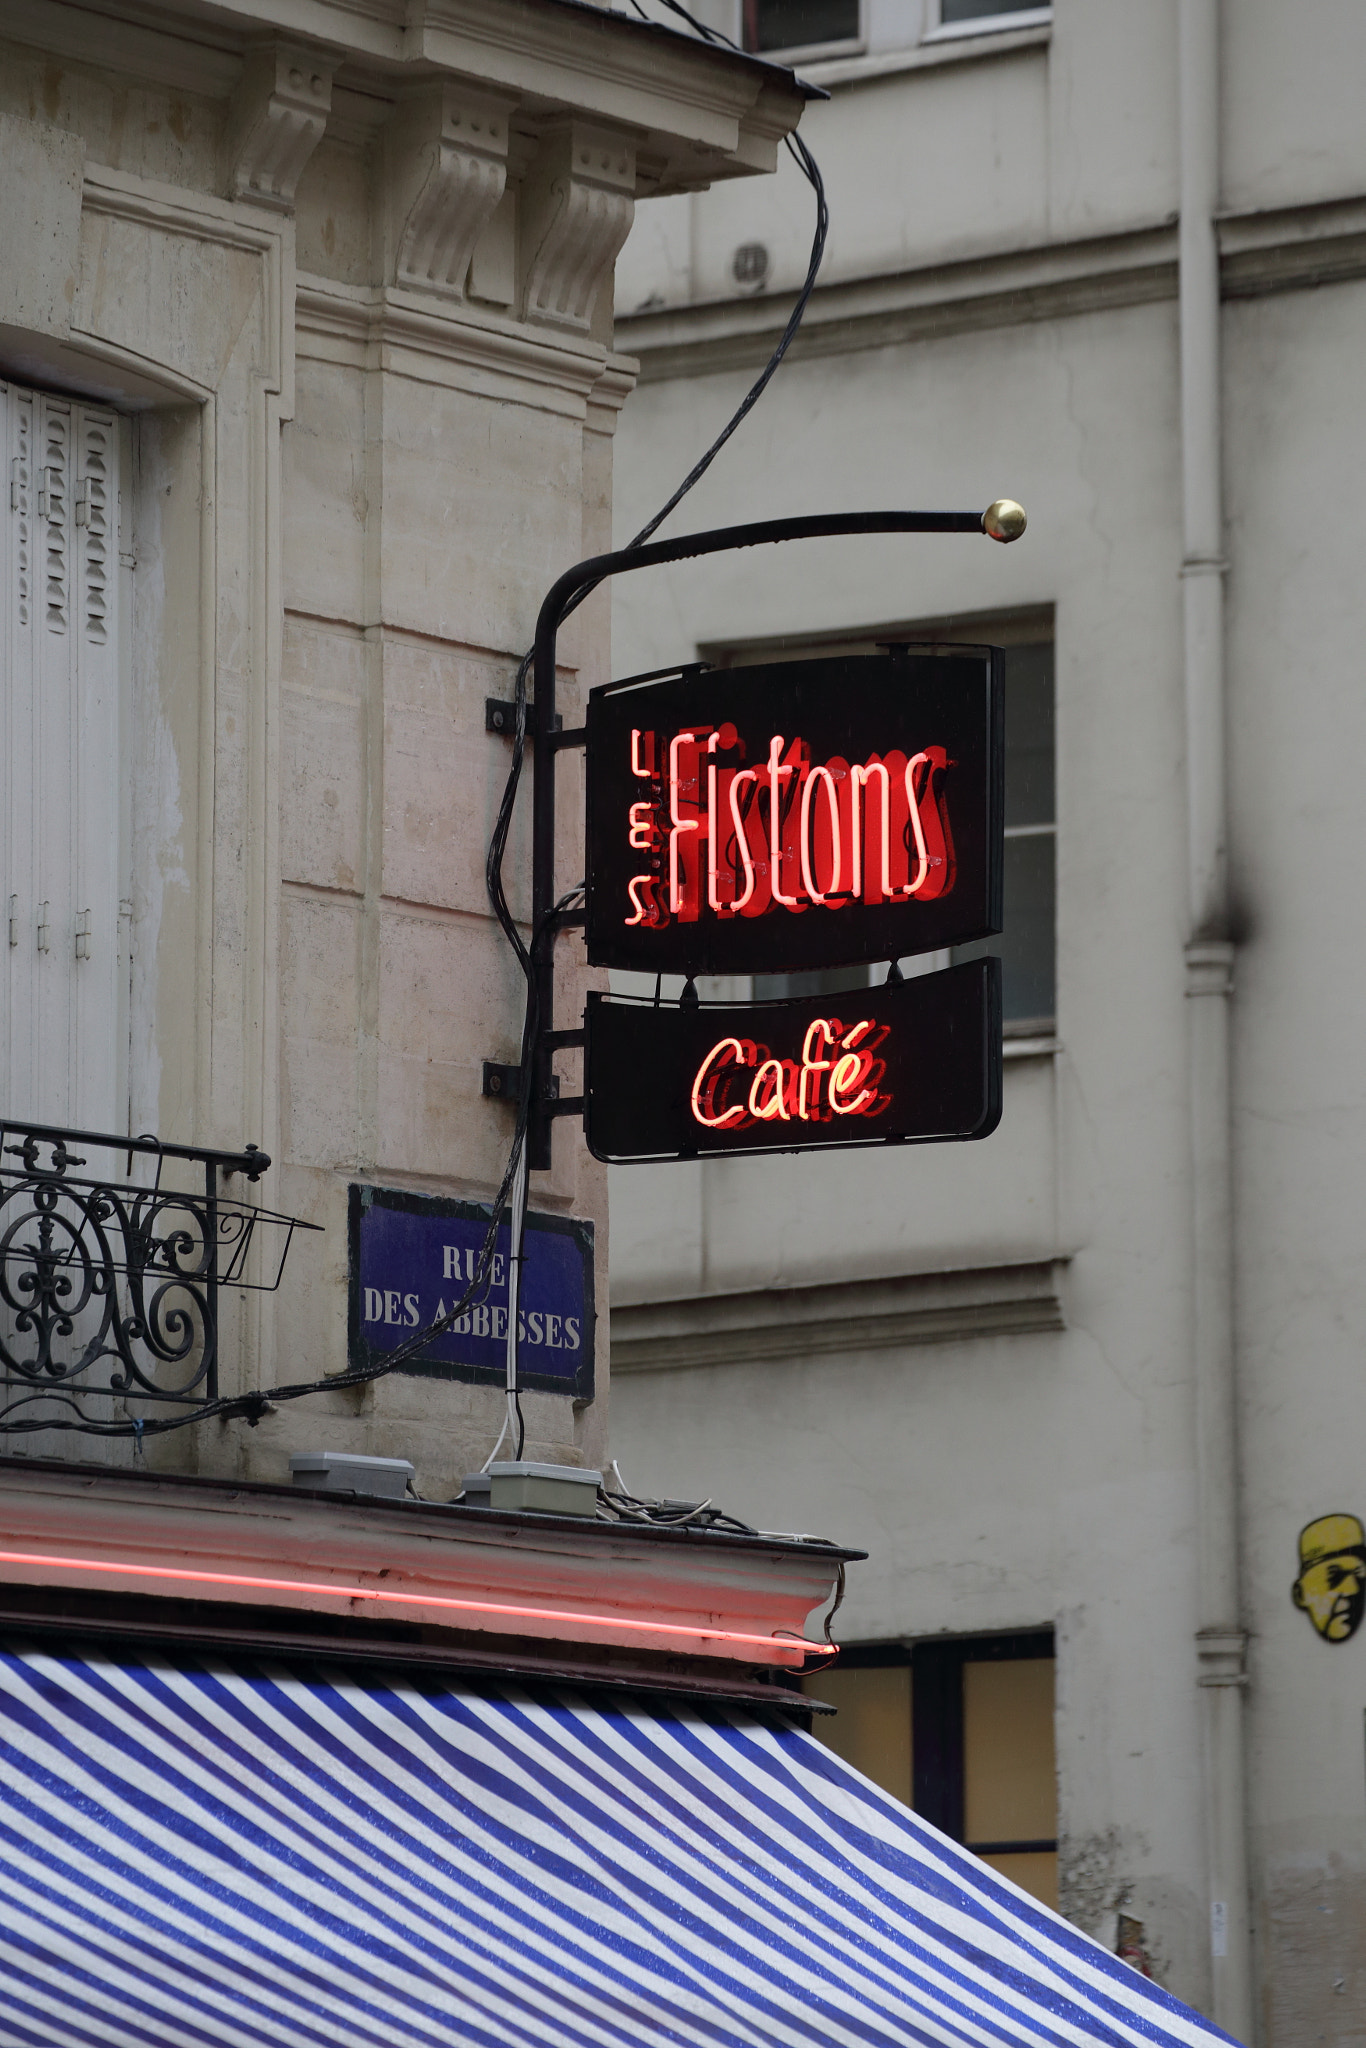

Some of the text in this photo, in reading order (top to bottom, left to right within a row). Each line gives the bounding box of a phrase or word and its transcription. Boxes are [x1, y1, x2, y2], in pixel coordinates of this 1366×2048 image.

[668, 728, 942, 914] Fistons
[691, 1018, 880, 1128] Café
[442, 1245, 505, 1287] RUE
[364, 1287, 420, 1327] DES
